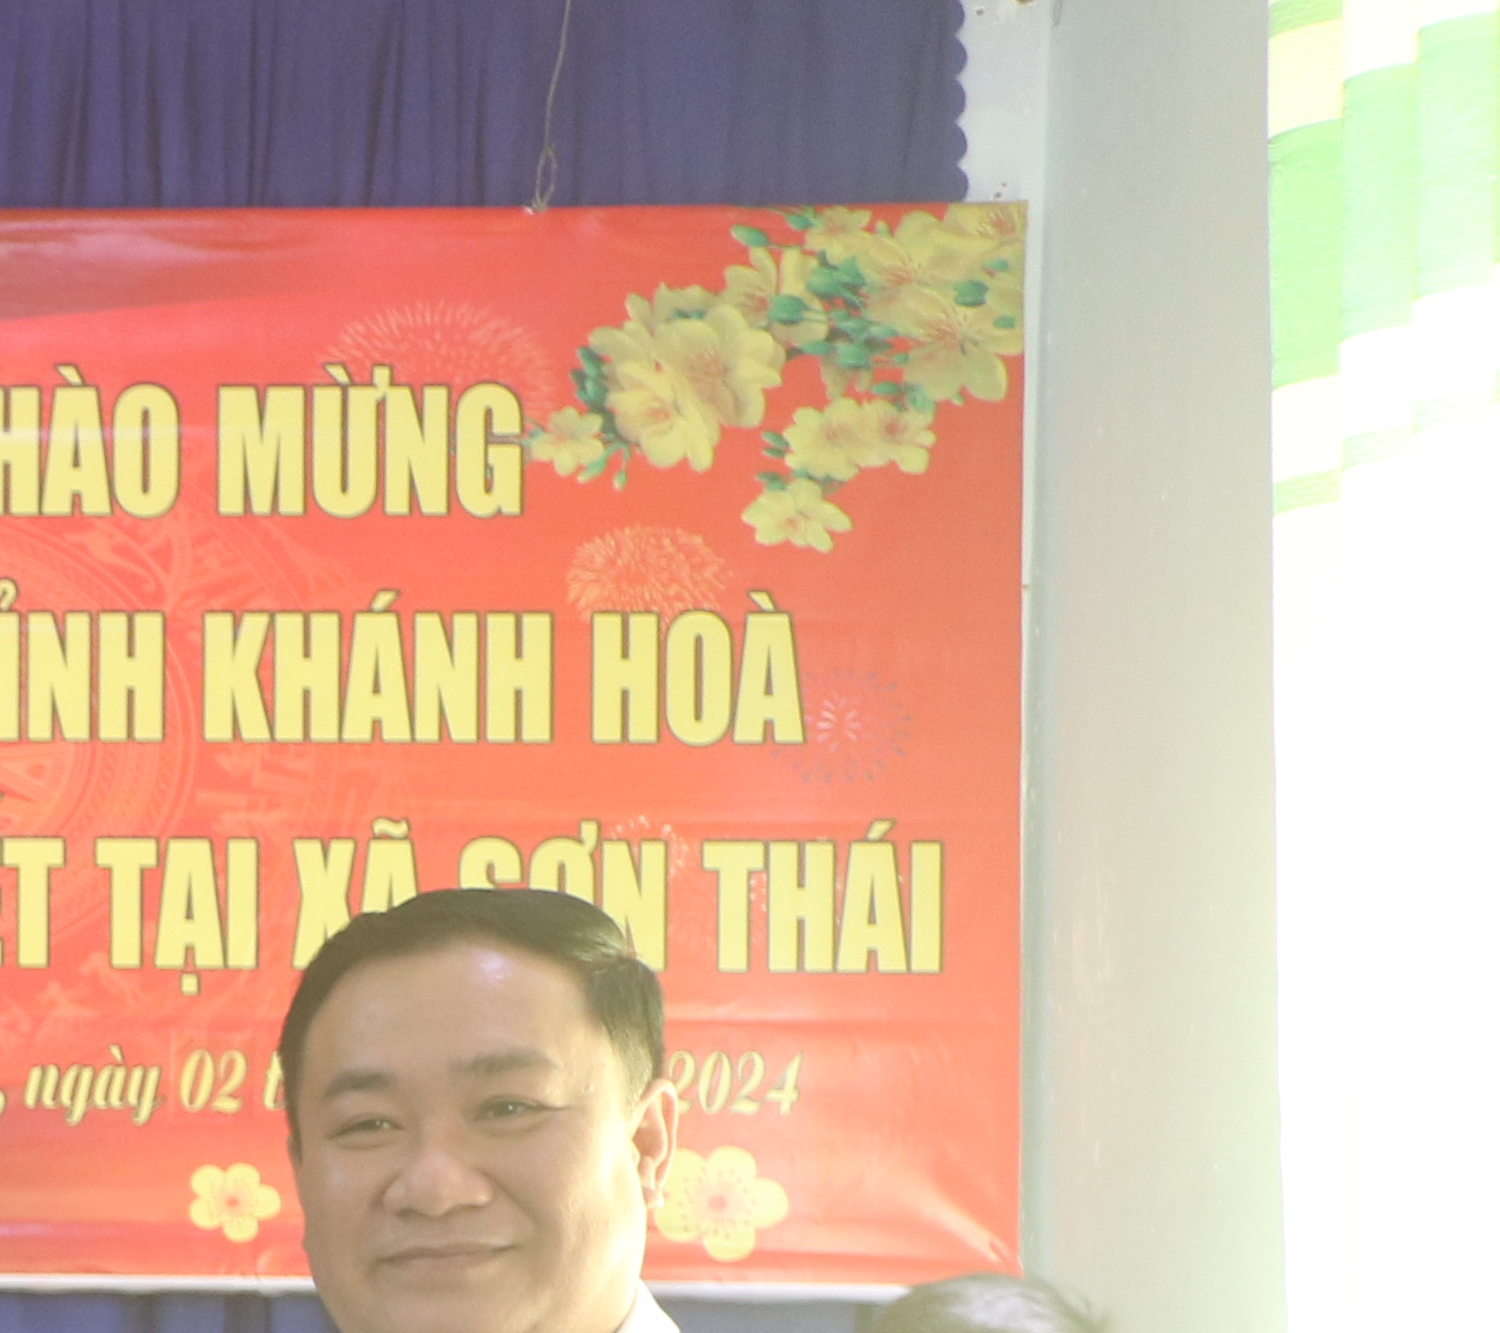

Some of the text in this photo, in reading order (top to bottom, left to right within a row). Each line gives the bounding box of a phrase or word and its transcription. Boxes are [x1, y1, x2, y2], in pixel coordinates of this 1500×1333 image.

[216, 362, 524, 521] MỪNG
[201, 589, 554, 746] KHÁNH
[590, 589, 807, 747] HOÀ
[94, 833, 259, 996] TẠI
[702, 818, 943, 975] THÁI
[24, 1043, 162, 1127] ngày
[179, 1048, 247, 1115] 02
[667, 1050, 804, 1115] 2024
